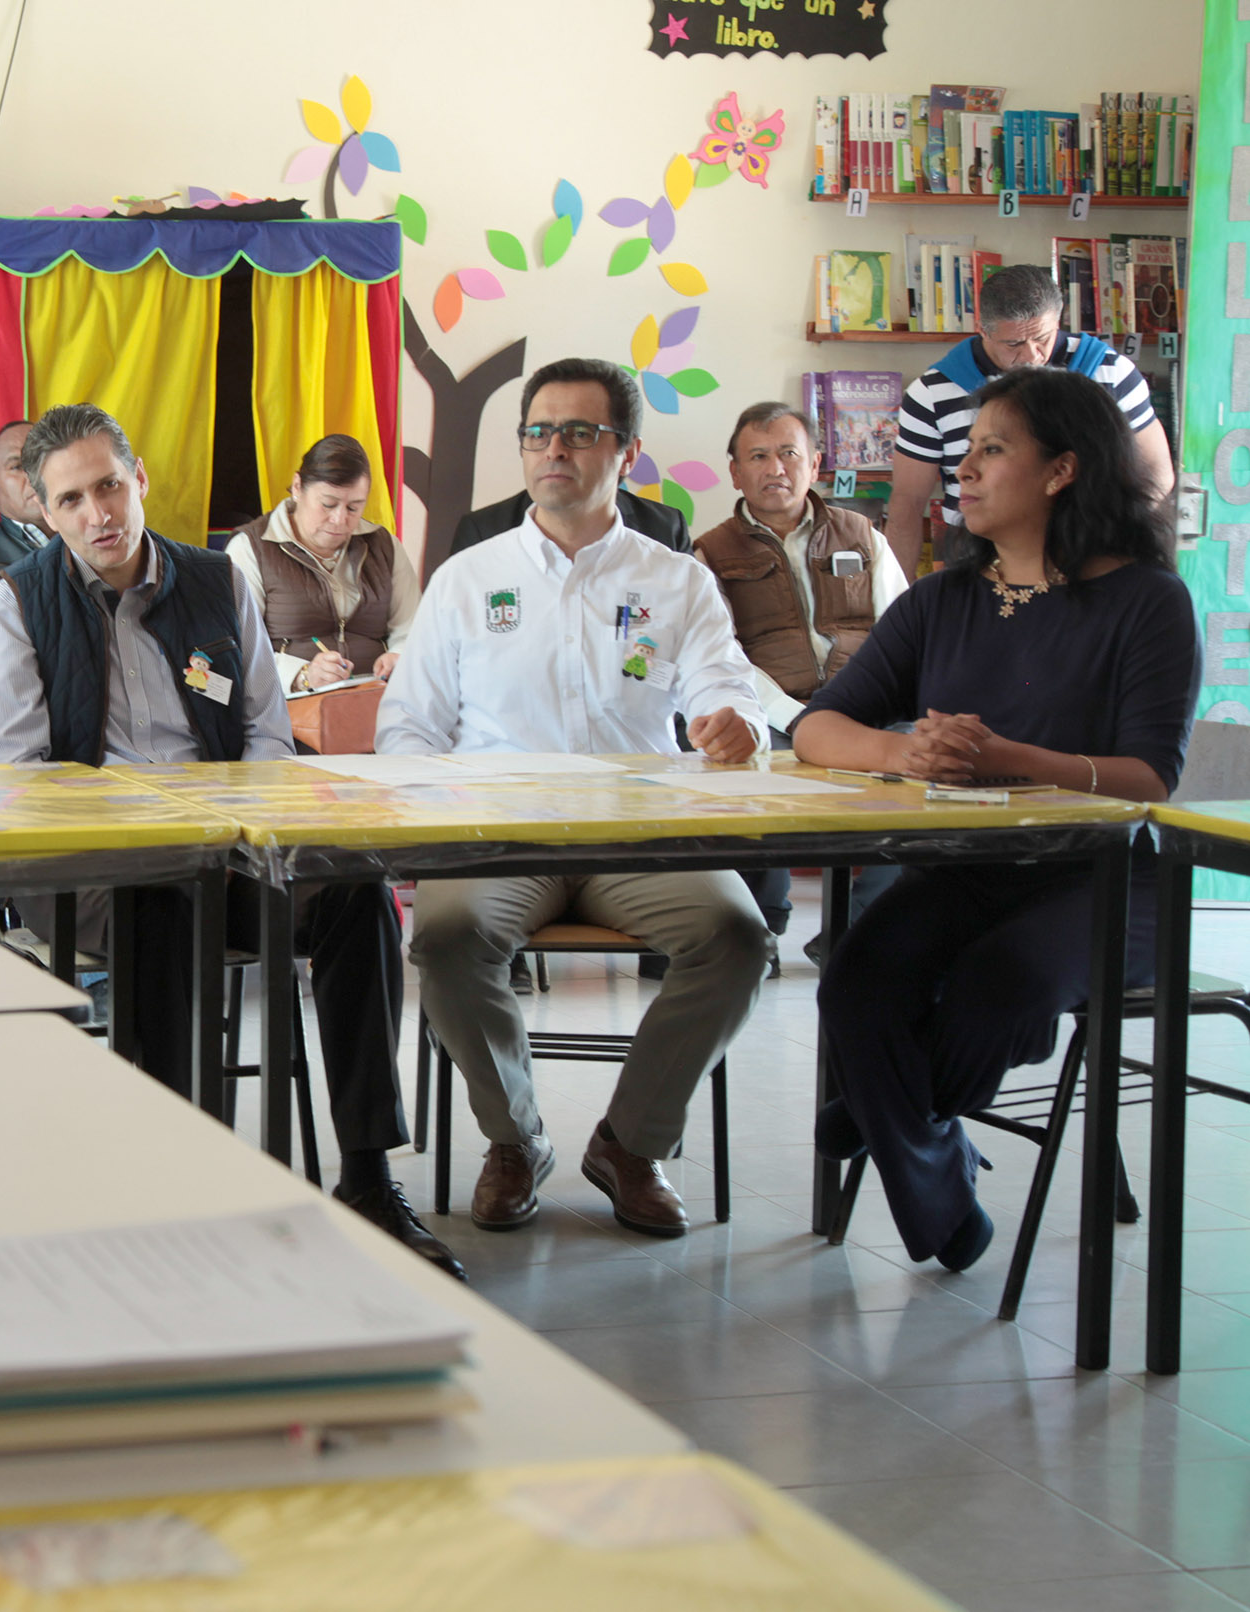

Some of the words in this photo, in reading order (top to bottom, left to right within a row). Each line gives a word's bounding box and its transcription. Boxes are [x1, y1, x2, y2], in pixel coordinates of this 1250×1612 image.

[740, 0, 784, 21] que
[805, 0, 836, 16] un
[716, 15, 779, 49] libro.
[850, 191, 863, 214] A
[1003, 192, 1014, 215] B
[1072, 197, 1084, 218] C
[1124, 335, 1137, 356] G
[1161, 336, 1174, 355] H
[832, 380, 890, 392] MÉXICO
[832, 391, 890, 399] INDEPENDIENTE
[836, 475, 853, 494] M
